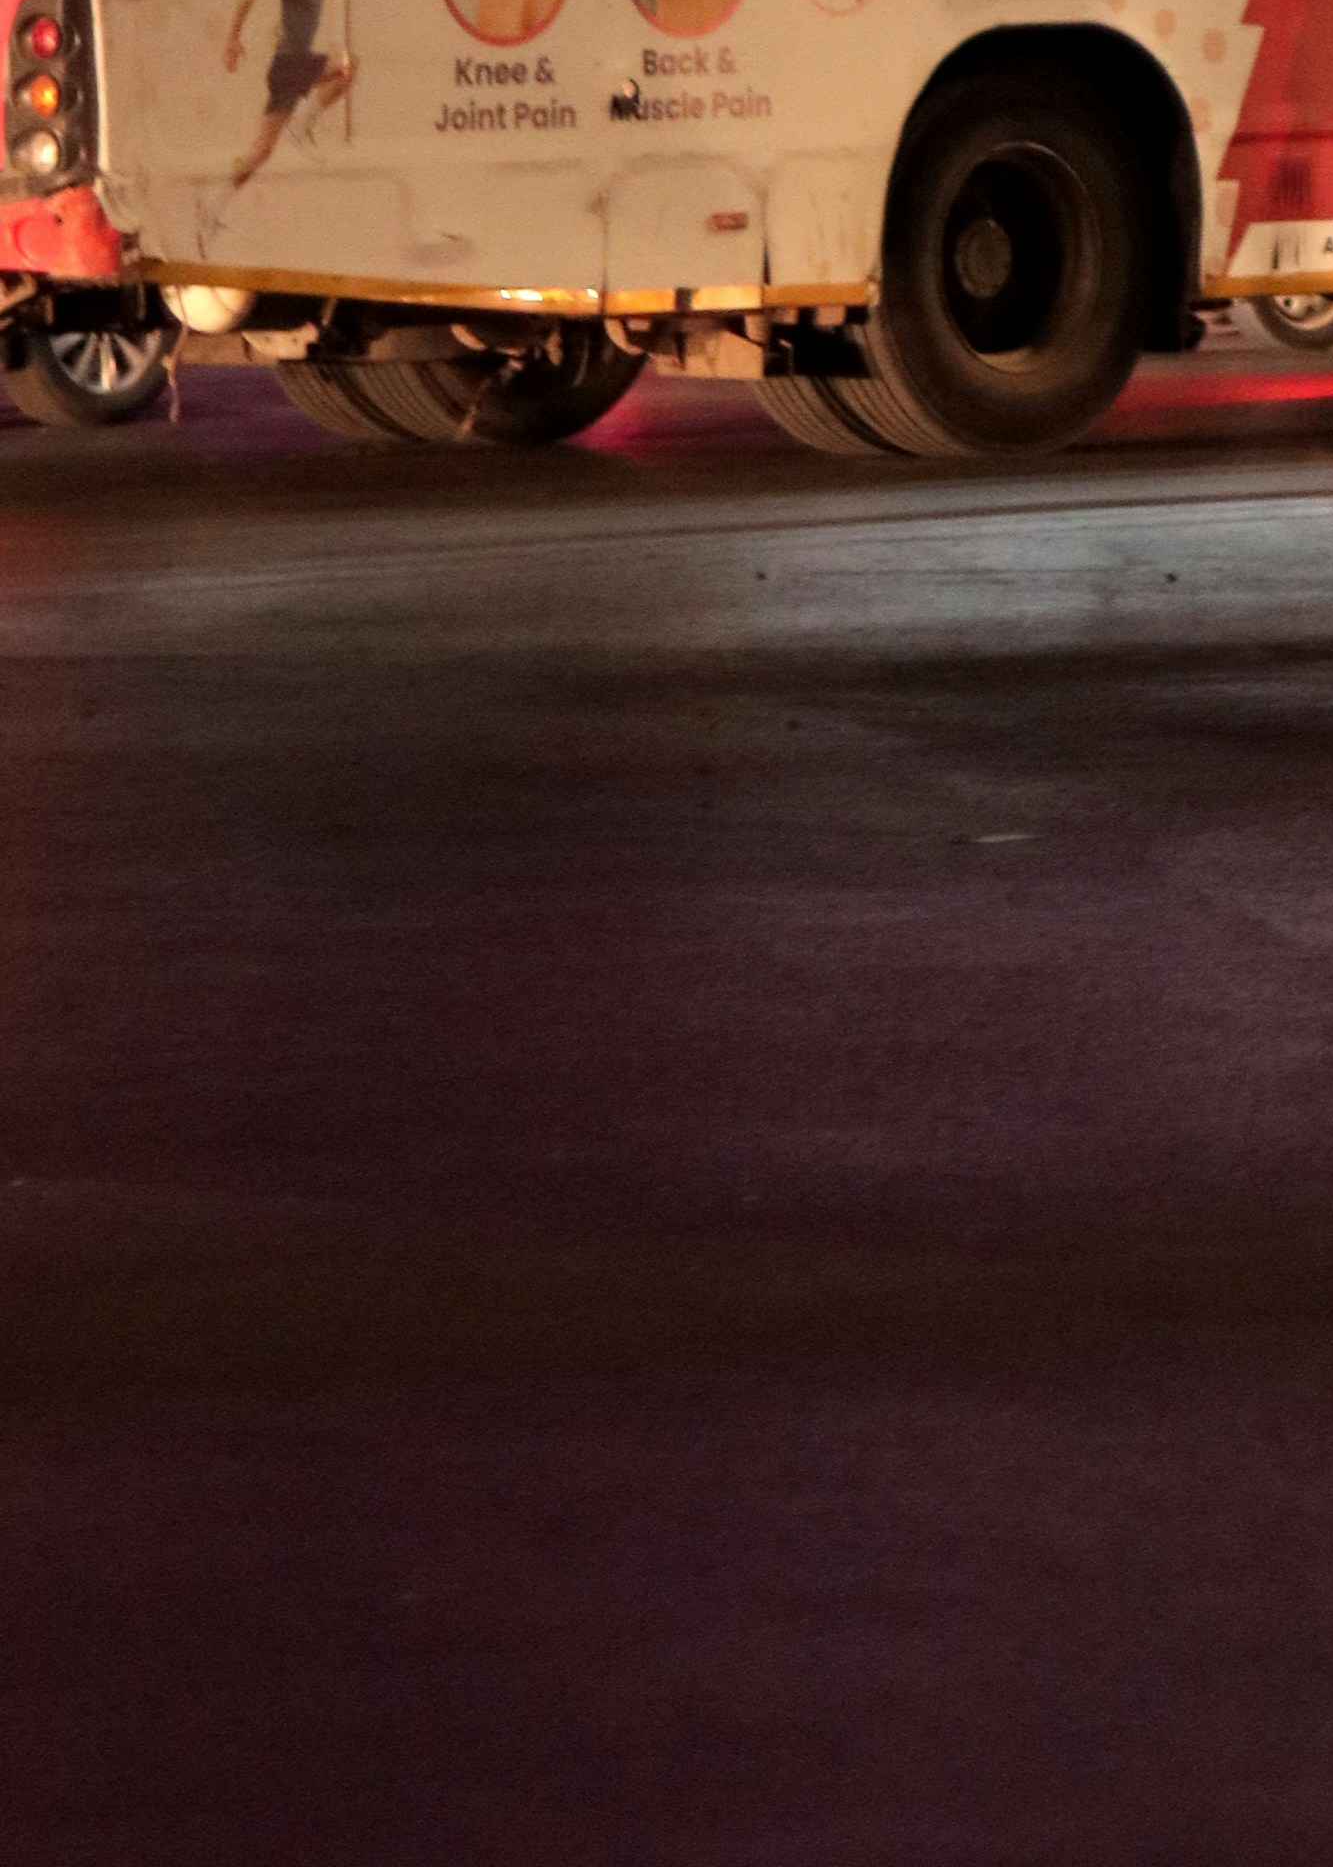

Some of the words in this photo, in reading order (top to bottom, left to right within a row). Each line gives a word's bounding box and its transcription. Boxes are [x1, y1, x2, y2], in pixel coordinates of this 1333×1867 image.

[455, 58, 528, 86] Knee
[534, 56, 555, 85] &
[643, 45, 710, 77] Back
[717, 45, 737, 75] &
[434, 100, 507, 133] Joint
[514, 99, 577, 130] Pain
[712, 88, 774, 120] Pain
